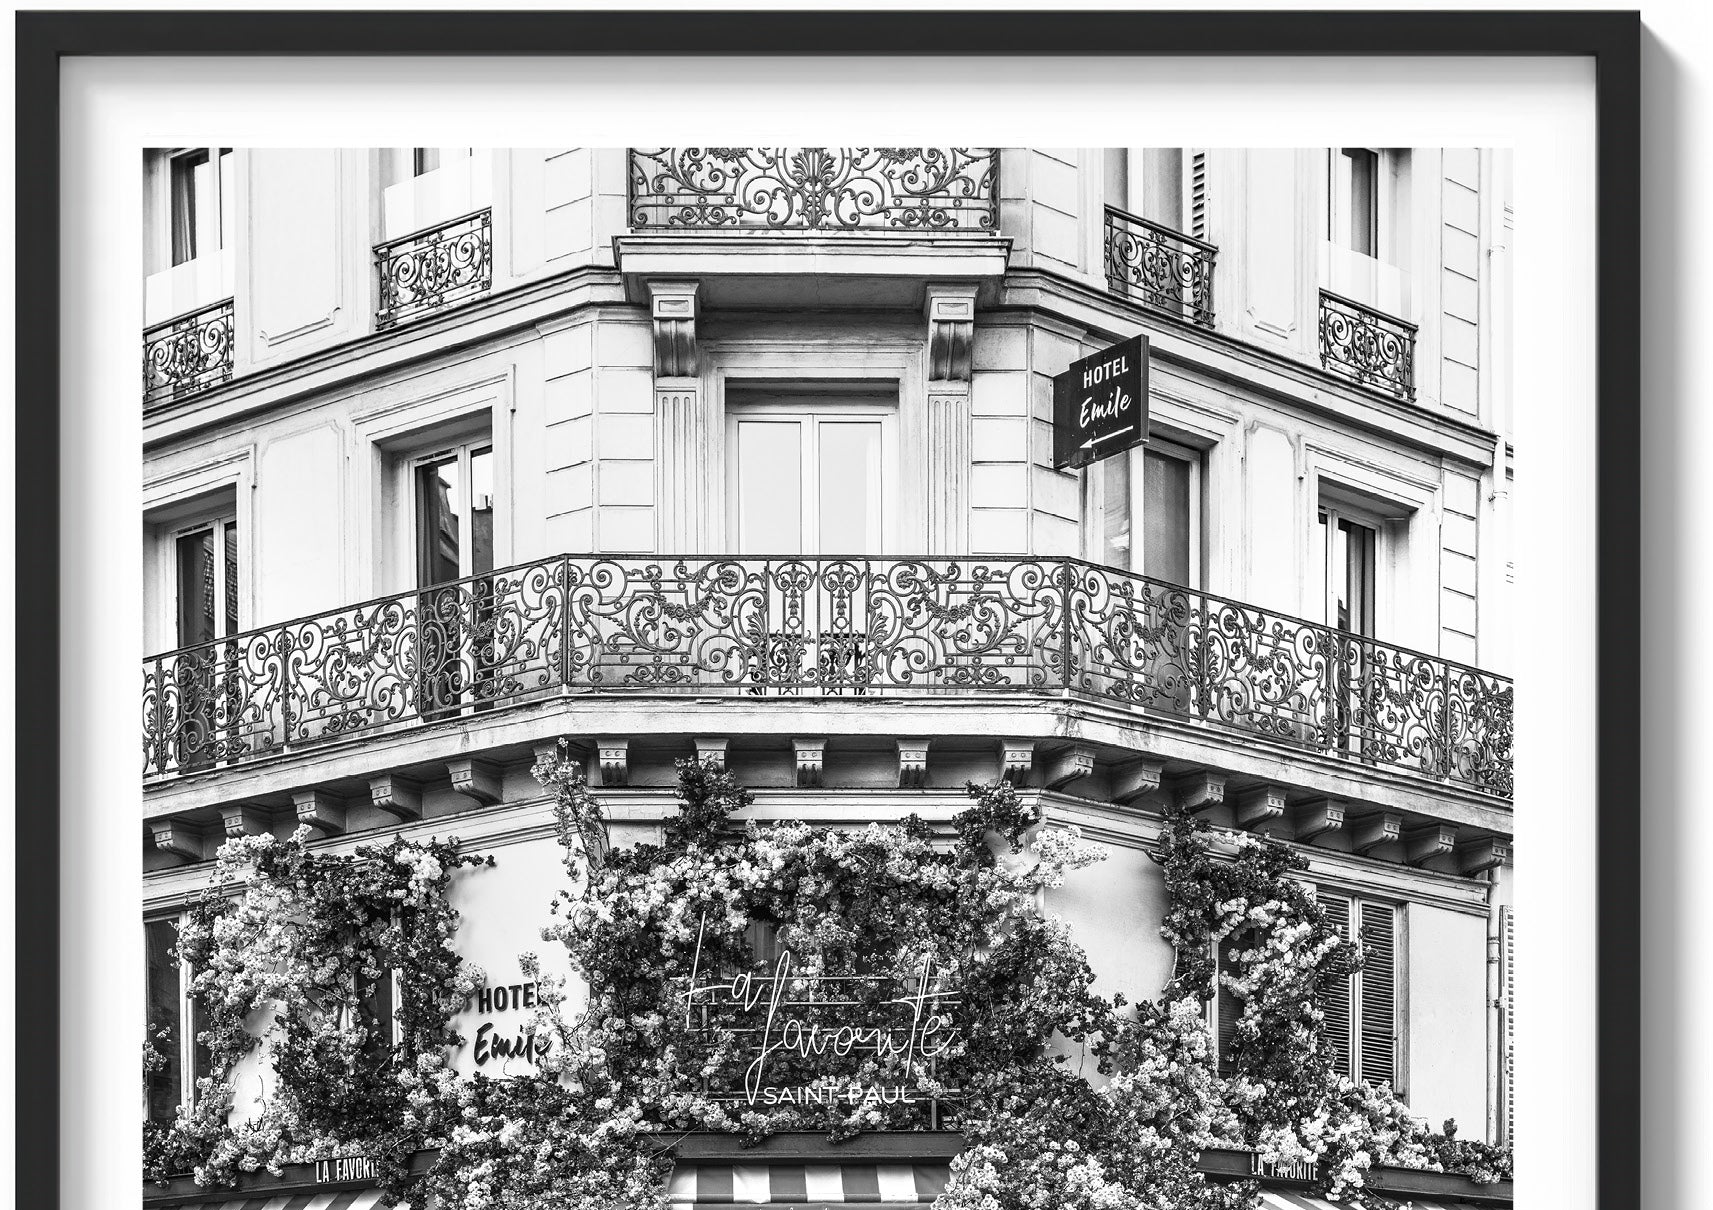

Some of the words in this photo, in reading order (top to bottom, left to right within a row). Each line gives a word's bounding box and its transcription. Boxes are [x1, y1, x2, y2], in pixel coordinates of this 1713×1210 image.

[1083, 355, 1129, 389] HOTEL
[1079, 385, 1132, 429] Emile
[679, 910, 763, 1029] La
[745, 950, 960, 1106] favorite
[763, 1086, 916, 1104] SAINT-PAUL
[315, 1159, 330, 1183] LA
[336, 1156, 381, 1181] FAVORI
